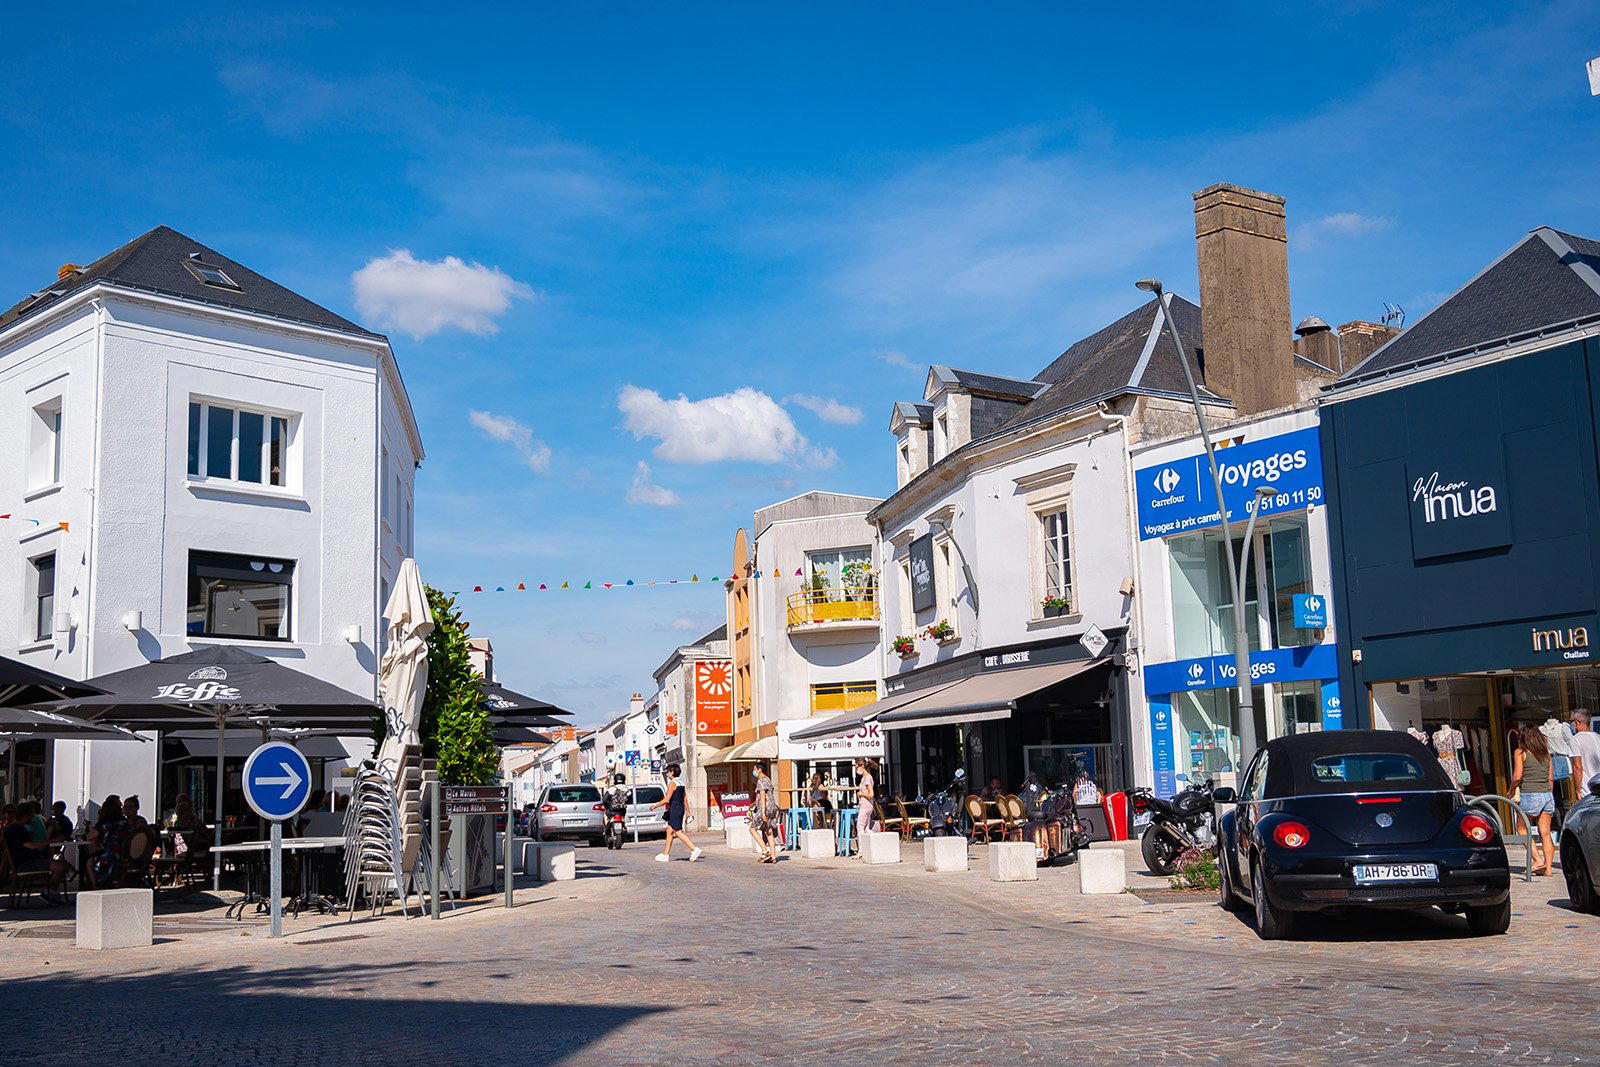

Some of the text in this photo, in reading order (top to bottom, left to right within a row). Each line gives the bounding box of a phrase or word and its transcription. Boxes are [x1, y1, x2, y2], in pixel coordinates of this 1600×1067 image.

[1209, 449, 1307, 487] Voyages
[1412, 470, 1469, 502] Maison
[1151, 494, 1185, 509] Carrefour
[1245, 486, 1322, 514] 0 51 60 11 50
[1423, 485, 1497, 523] imua
[1144, 510, 1233, 536] Voyagez à prix carrefur
[1531, 626, 1589, 652] imua
[1563, 650, 1590, 660] Challans
[1219, 661, 1276, 679] Voges
[152, 681, 241, 702] Leffe
[807, 739, 880, 751] by camille mode
[452, 804, 470, 813] Autres
